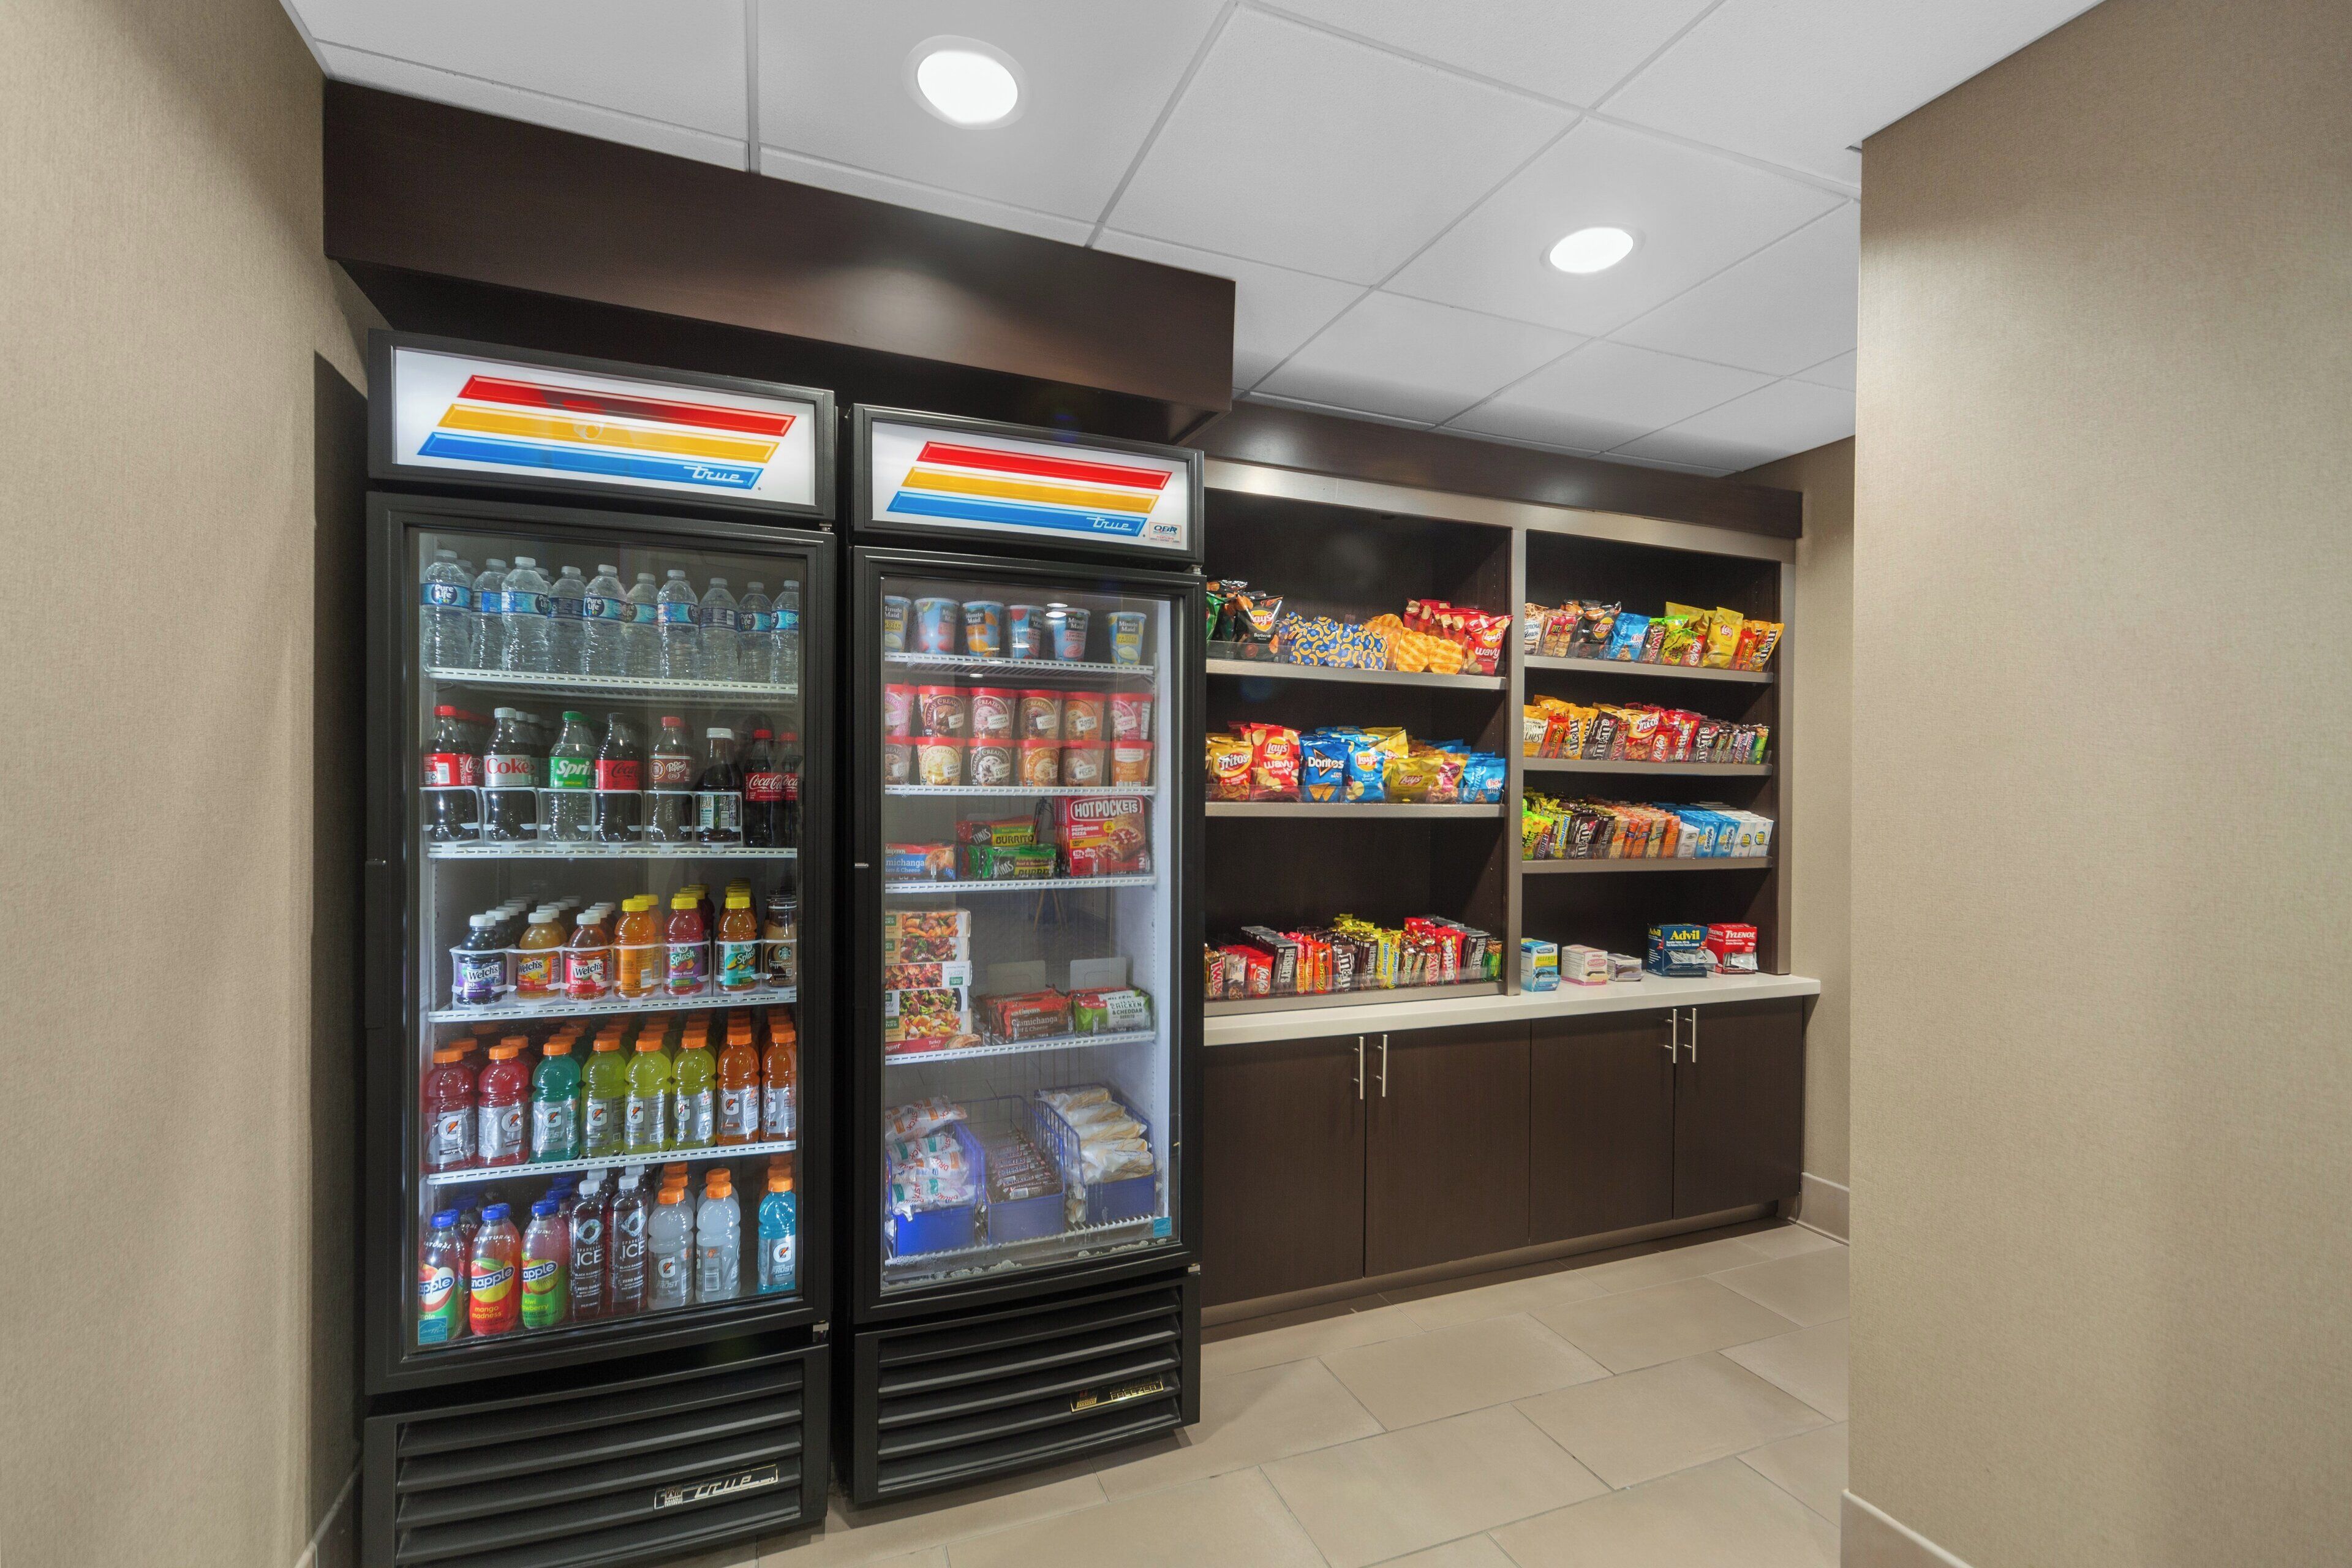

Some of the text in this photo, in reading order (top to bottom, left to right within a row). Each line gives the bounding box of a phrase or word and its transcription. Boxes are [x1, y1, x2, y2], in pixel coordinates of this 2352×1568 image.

[1087, 517, 1132, 531] true
[435, 584, 453, 593] Pure
[436, 591, 451, 600] Life
[587, 603, 599, 611] Life
[1594, 622, 1613, 633] Lay's
[1474, 647, 1500, 658] wavy
[1267, 742, 1288, 756] Lay's
[486, 758, 530, 775] Coke
[666, 763, 686, 772] Pepper
[1218, 755, 1249, 771] Fritos
[1264, 760, 1294, 771] wavy
[1308, 756, 1344, 769] Doritos
[1357, 755, 1378, 766] Lay's
[1402, 775, 1423, 785] Lay's
[1487, 778, 1501, 788] Chex
[996, 834, 1034, 844] BURRITO
[1724, 829, 1733, 850] Snuggle
[886, 859, 925, 867] michanga
[999, 860, 1014, 876] NA'S
[1670, 930, 1700, 940] Advil
[671, 951, 696, 967] Splash
[1365, 945, 1377, 979] HERSHEY'S
[1443, 939, 1455, 981] Skittles
[1472, 938, 1486, 974] HERSHEY'S
[468, 964, 499, 980] Welch's
[575, 962, 603, 978] Welch's
[1281, 948, 1296, 983] HERSHEY'S
[1427, 953, 1439, 984] TWIX
[1211, 959, 1224, 995] TWIX
[1011, 1016, 1058, 1026] Chimichanga
[773, 1242, 791, 1263] G
[523, 1262, 556, 1281] apple
[771, 1265, 794, 1275] FROST
[472, 1266, 513, 1291] napple
[1110, 1385, 1156, 1400] FREEZER
